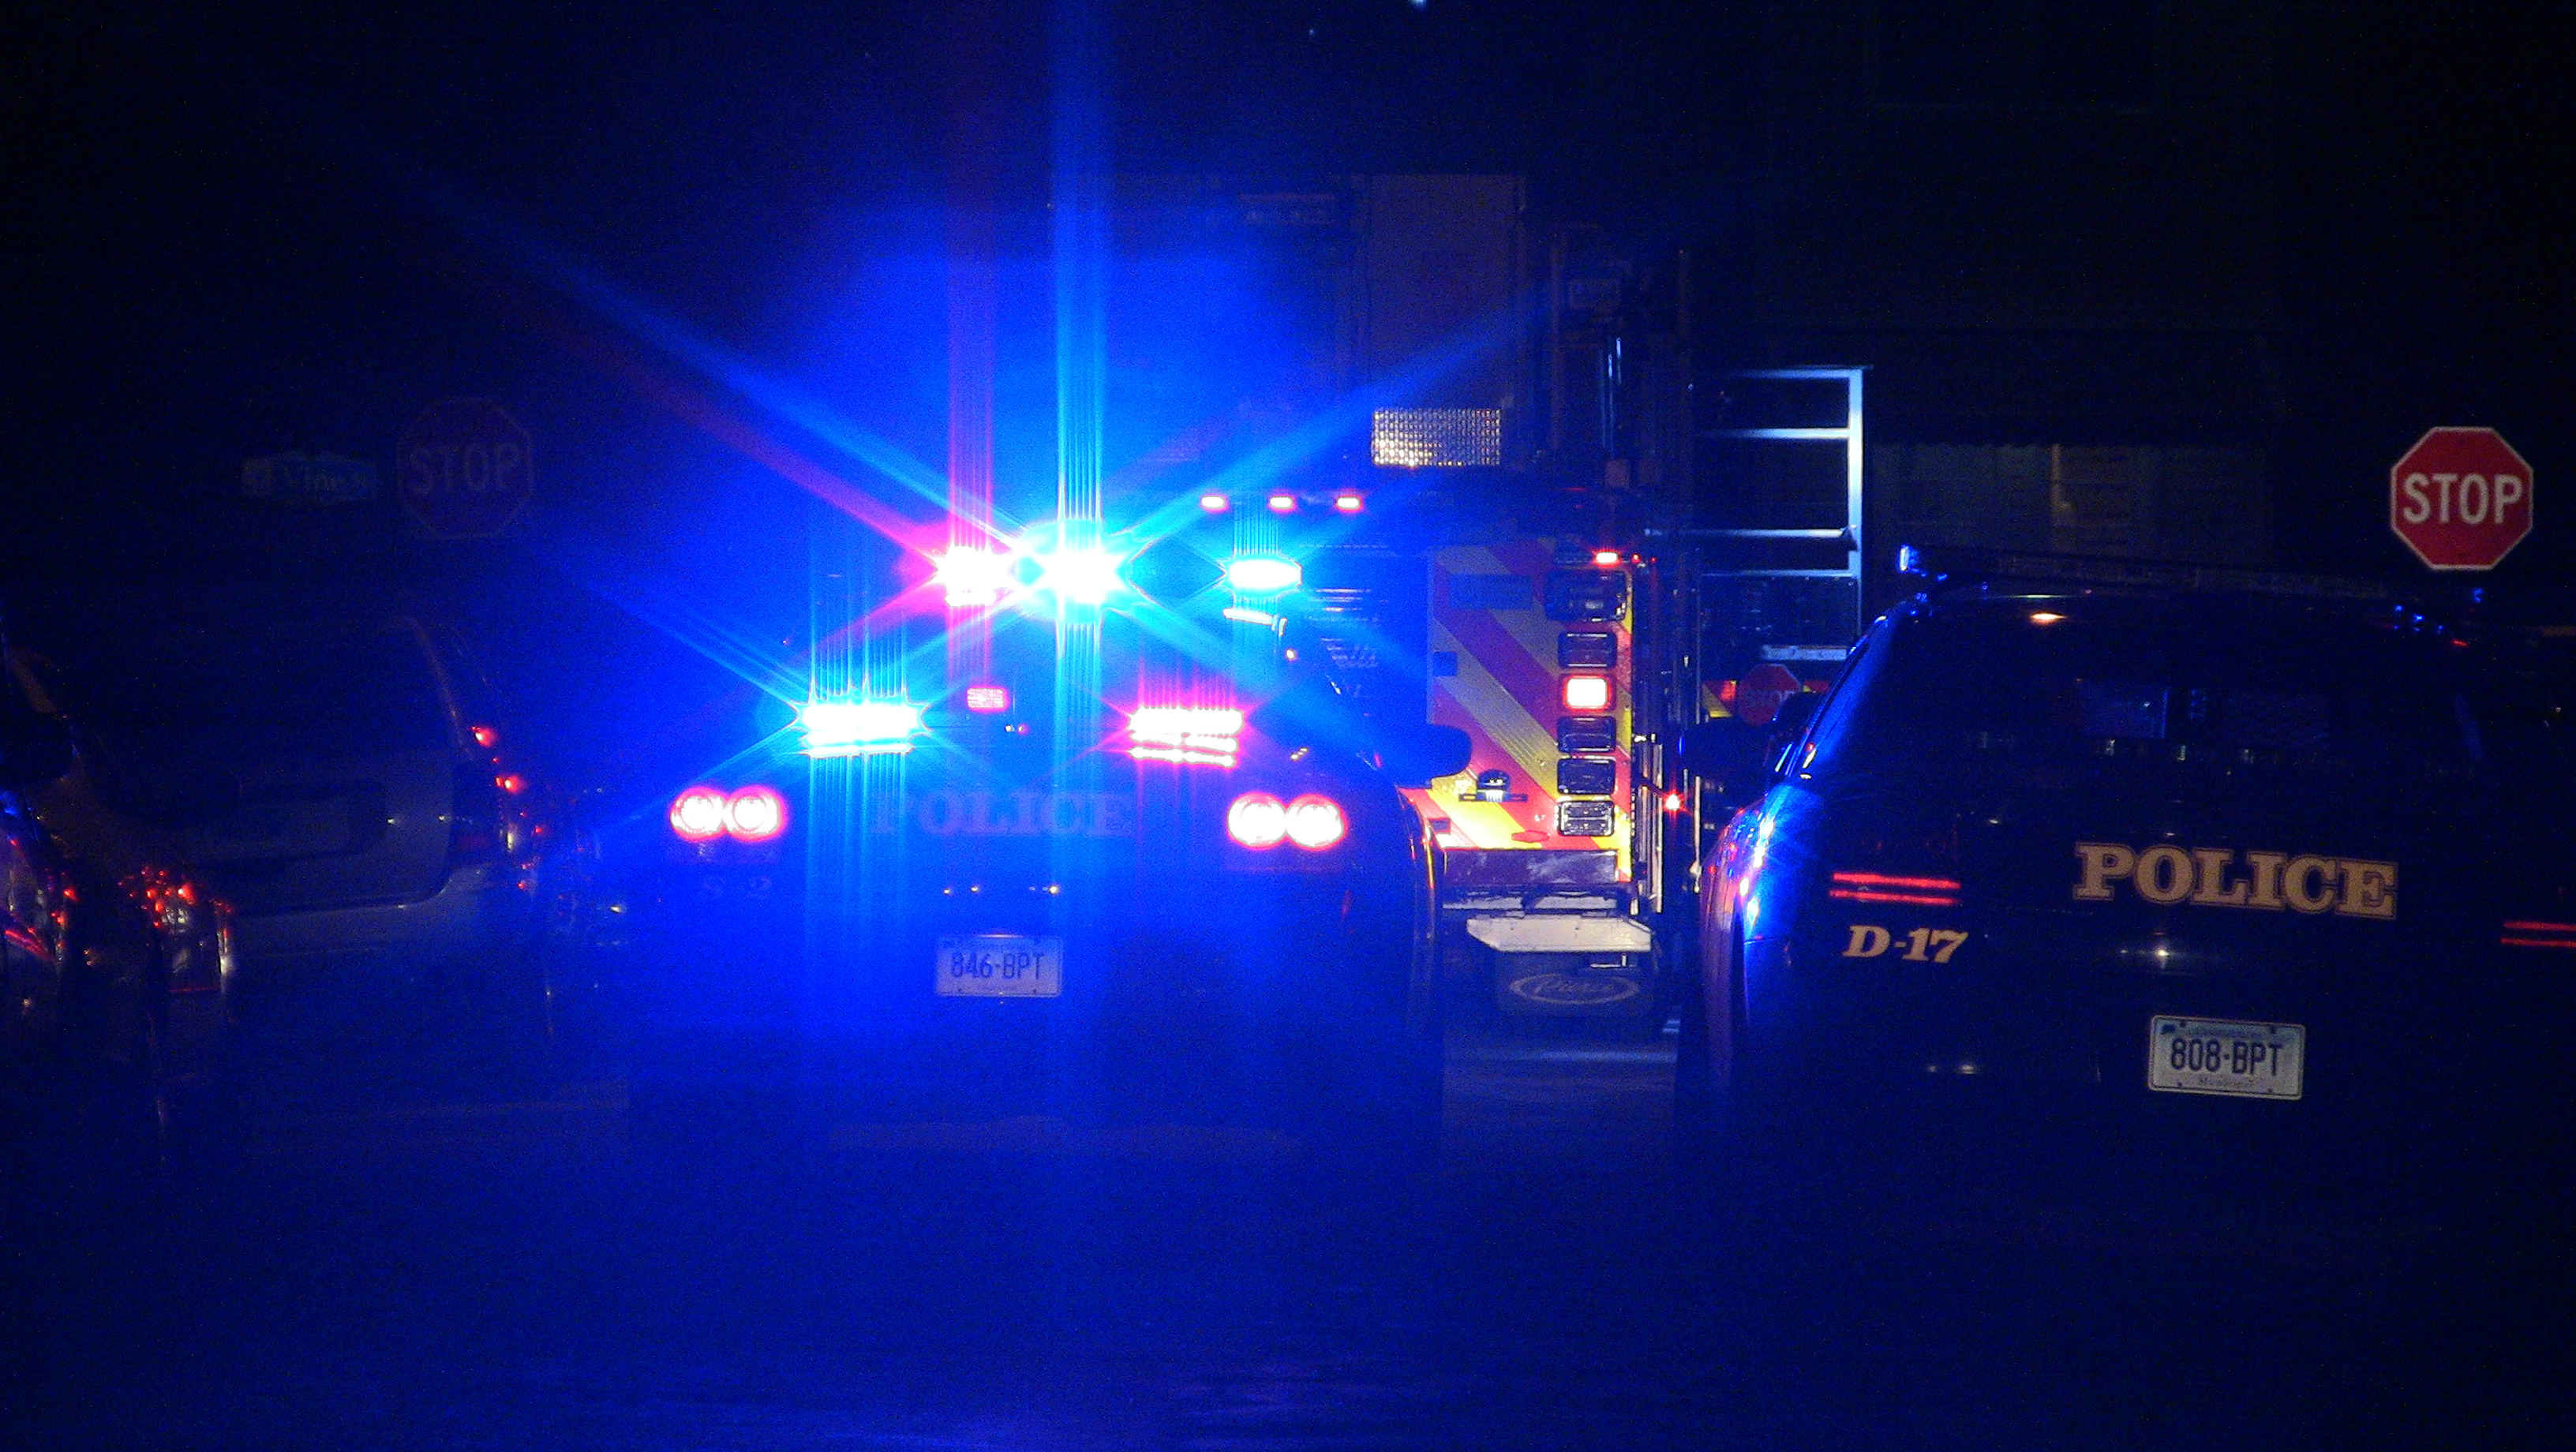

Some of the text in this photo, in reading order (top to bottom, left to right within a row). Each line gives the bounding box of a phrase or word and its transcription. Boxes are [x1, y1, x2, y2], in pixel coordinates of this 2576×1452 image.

[409, 442, 521, 494] STOP
[2403, 473, 2523, 524] STOP
[870, 791, 1135, 837] POLICE
[2072, 841, 2399, 920] POLICE
[951, 952, 1044, 979] 846-BPT
[1842, 925, 1969, 964] D-17
[2170, 1037, 2283, 1076] 808-BPT
